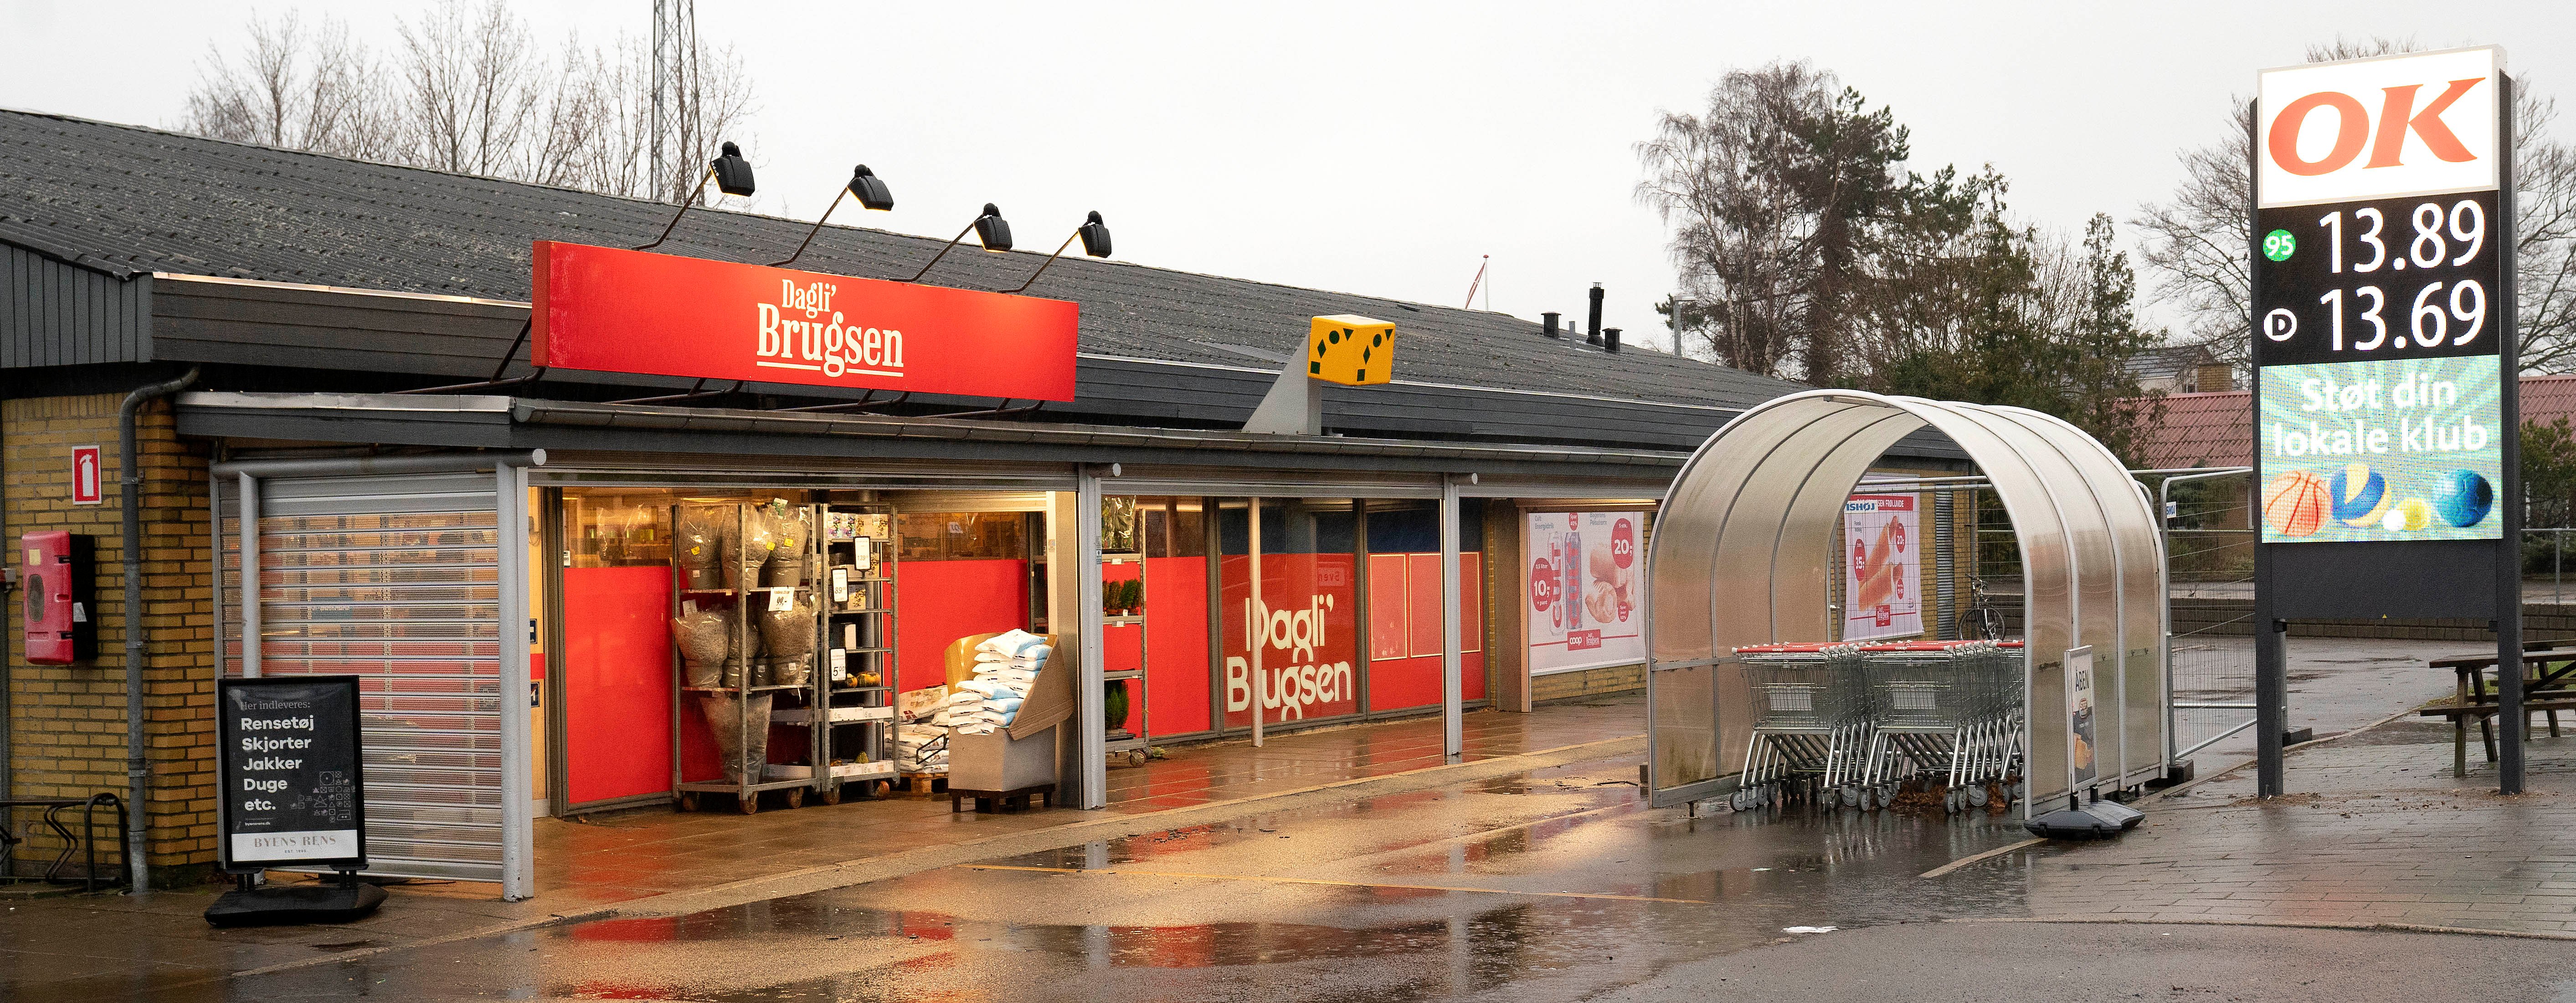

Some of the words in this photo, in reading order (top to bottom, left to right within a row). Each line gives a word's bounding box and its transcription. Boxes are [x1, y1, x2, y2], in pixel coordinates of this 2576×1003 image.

[2268, 77, 2486, 176] OK
[2266, 235, 2294, 256] 95
[2319, 200, 2485, 273] 13.89
[782, 279, 837, 319] Dagli'
[2272, 314, 2292, 336] D
[2320, 279, 2486, 351] 13.69
[756, 303, 904, 377] Brugsen
[2302, 378, 2382, 412] Støt
[2393, 372, 2456, 408] din
[2273, 418, 2389, 456] lokale
[2401, 415, 2487, 452] klub
[1846, 502, 1875, 511] ISHØJ
[2166, 505, 2175, 515] SHØJ
[1567, 542, 1579, 627] CULT
[1245, 594, 1334, 664] Dagli'
[1569, 636, 1582, 646] coop
[1227, 656, 1352, 722] Bugsen
[2075, 665, 2089, 692] ÅBEN
[240, 701, 257, 710] Her
[260, 701, 310, 710] indleveres:
[241, 715, 314, 731] Rensetøj
[242, 736, 312, 752] Skjorter
[243, 757, 303, 770] Jakker
[244, 778, 288, 793] Duge
[244, 798, 276, 811] etc.
[254, 837, 297, 847] BYENS
[303, 835, 336, 846] RENS
